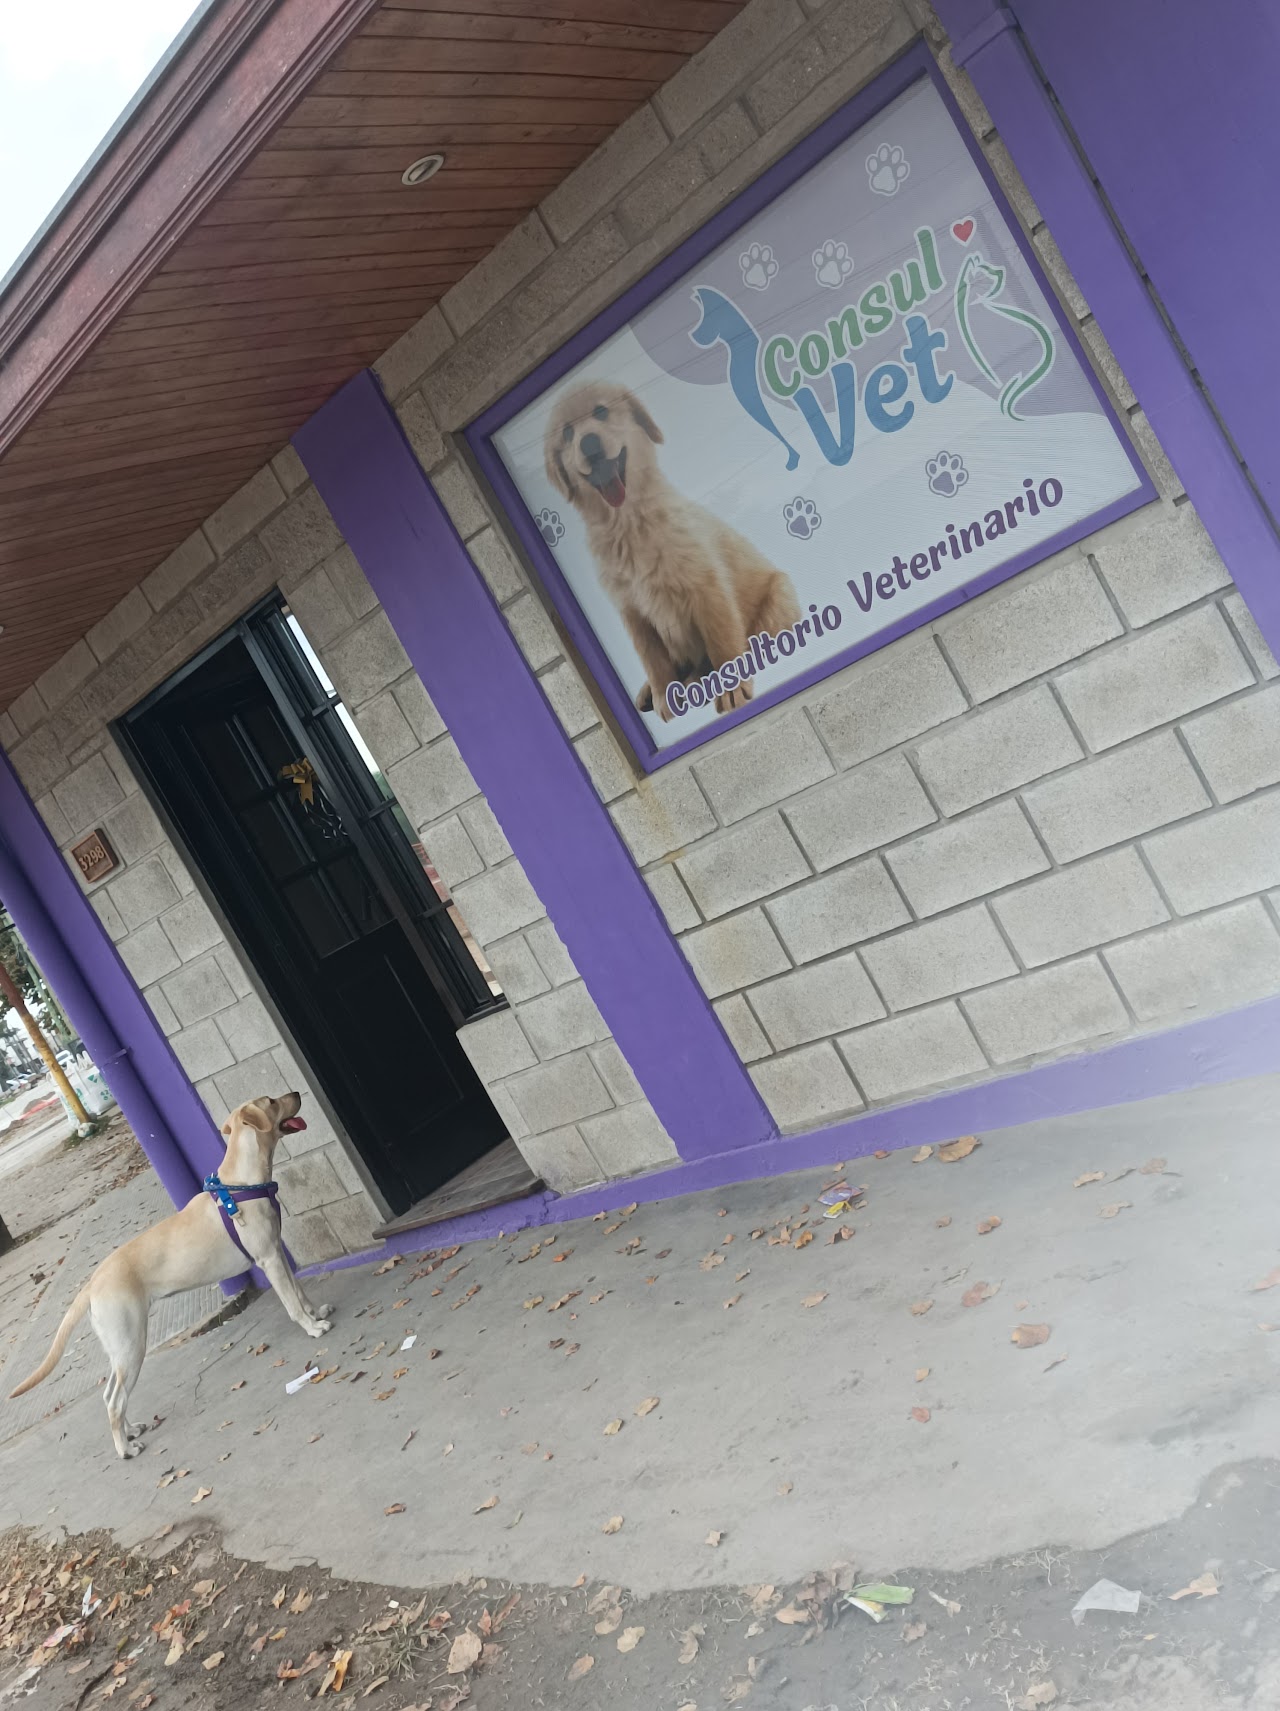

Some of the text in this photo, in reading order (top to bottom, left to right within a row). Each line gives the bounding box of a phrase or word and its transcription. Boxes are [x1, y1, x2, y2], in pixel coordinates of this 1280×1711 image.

[763, 228, 944, 397] Consul
[793, 315, 954, 467] Vet
[666, 477, 1064, 717] Consultorio Veterinario
[79, 846, 104, 871] 3298
